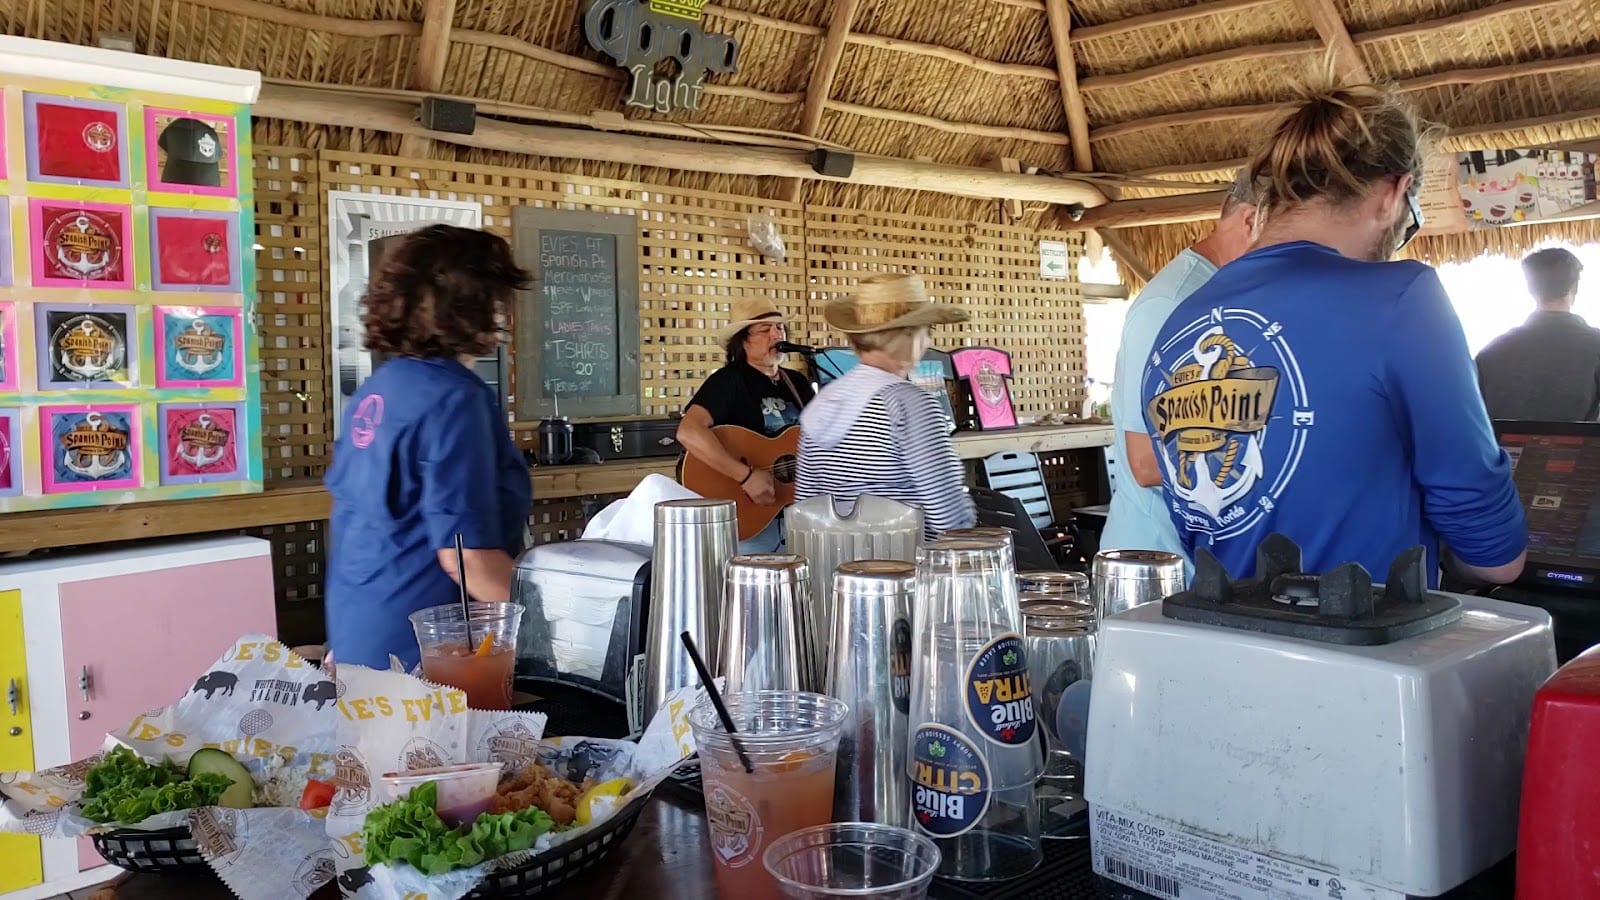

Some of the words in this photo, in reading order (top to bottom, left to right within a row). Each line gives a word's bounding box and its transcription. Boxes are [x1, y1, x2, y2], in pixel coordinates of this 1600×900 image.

[626, 64, 703, 113] Light
[1210, 307, 1224, 324] N
[1262, 321, 1283, 341] NE
[63, 335, 92, 349] Spanish
[1156, 388, 1208, 432] Spanish
[1209, 385, 1262, 423] Point
[1293, 410, 1314, 426] E
[66, 432, 99, 447] Spanish
[100, 432, 125, 447] Point
[1215, 504, 1246, 527] Florida
[1546, 571, 1584, 583] CYPRUS
[254, 679, 275, 692] WHITE
[275, 679, 302, 693] BUFFALO
[249, 689, 299, 707] SALOON
[991, 696, 1034, 724] Blue
[916, 785, 964, 821] Blue
[1096, 818, 1136, 838] COMMERCIAL
[1139, 831, 1158, 845] FOOD
[1159, 839, 1200, 859] PREPARING
[1201, 852, 1235, 868] MACHINE
[1157, 846, 1177, 858] AMPS
[1227, 867, 1251, 882] CODE
